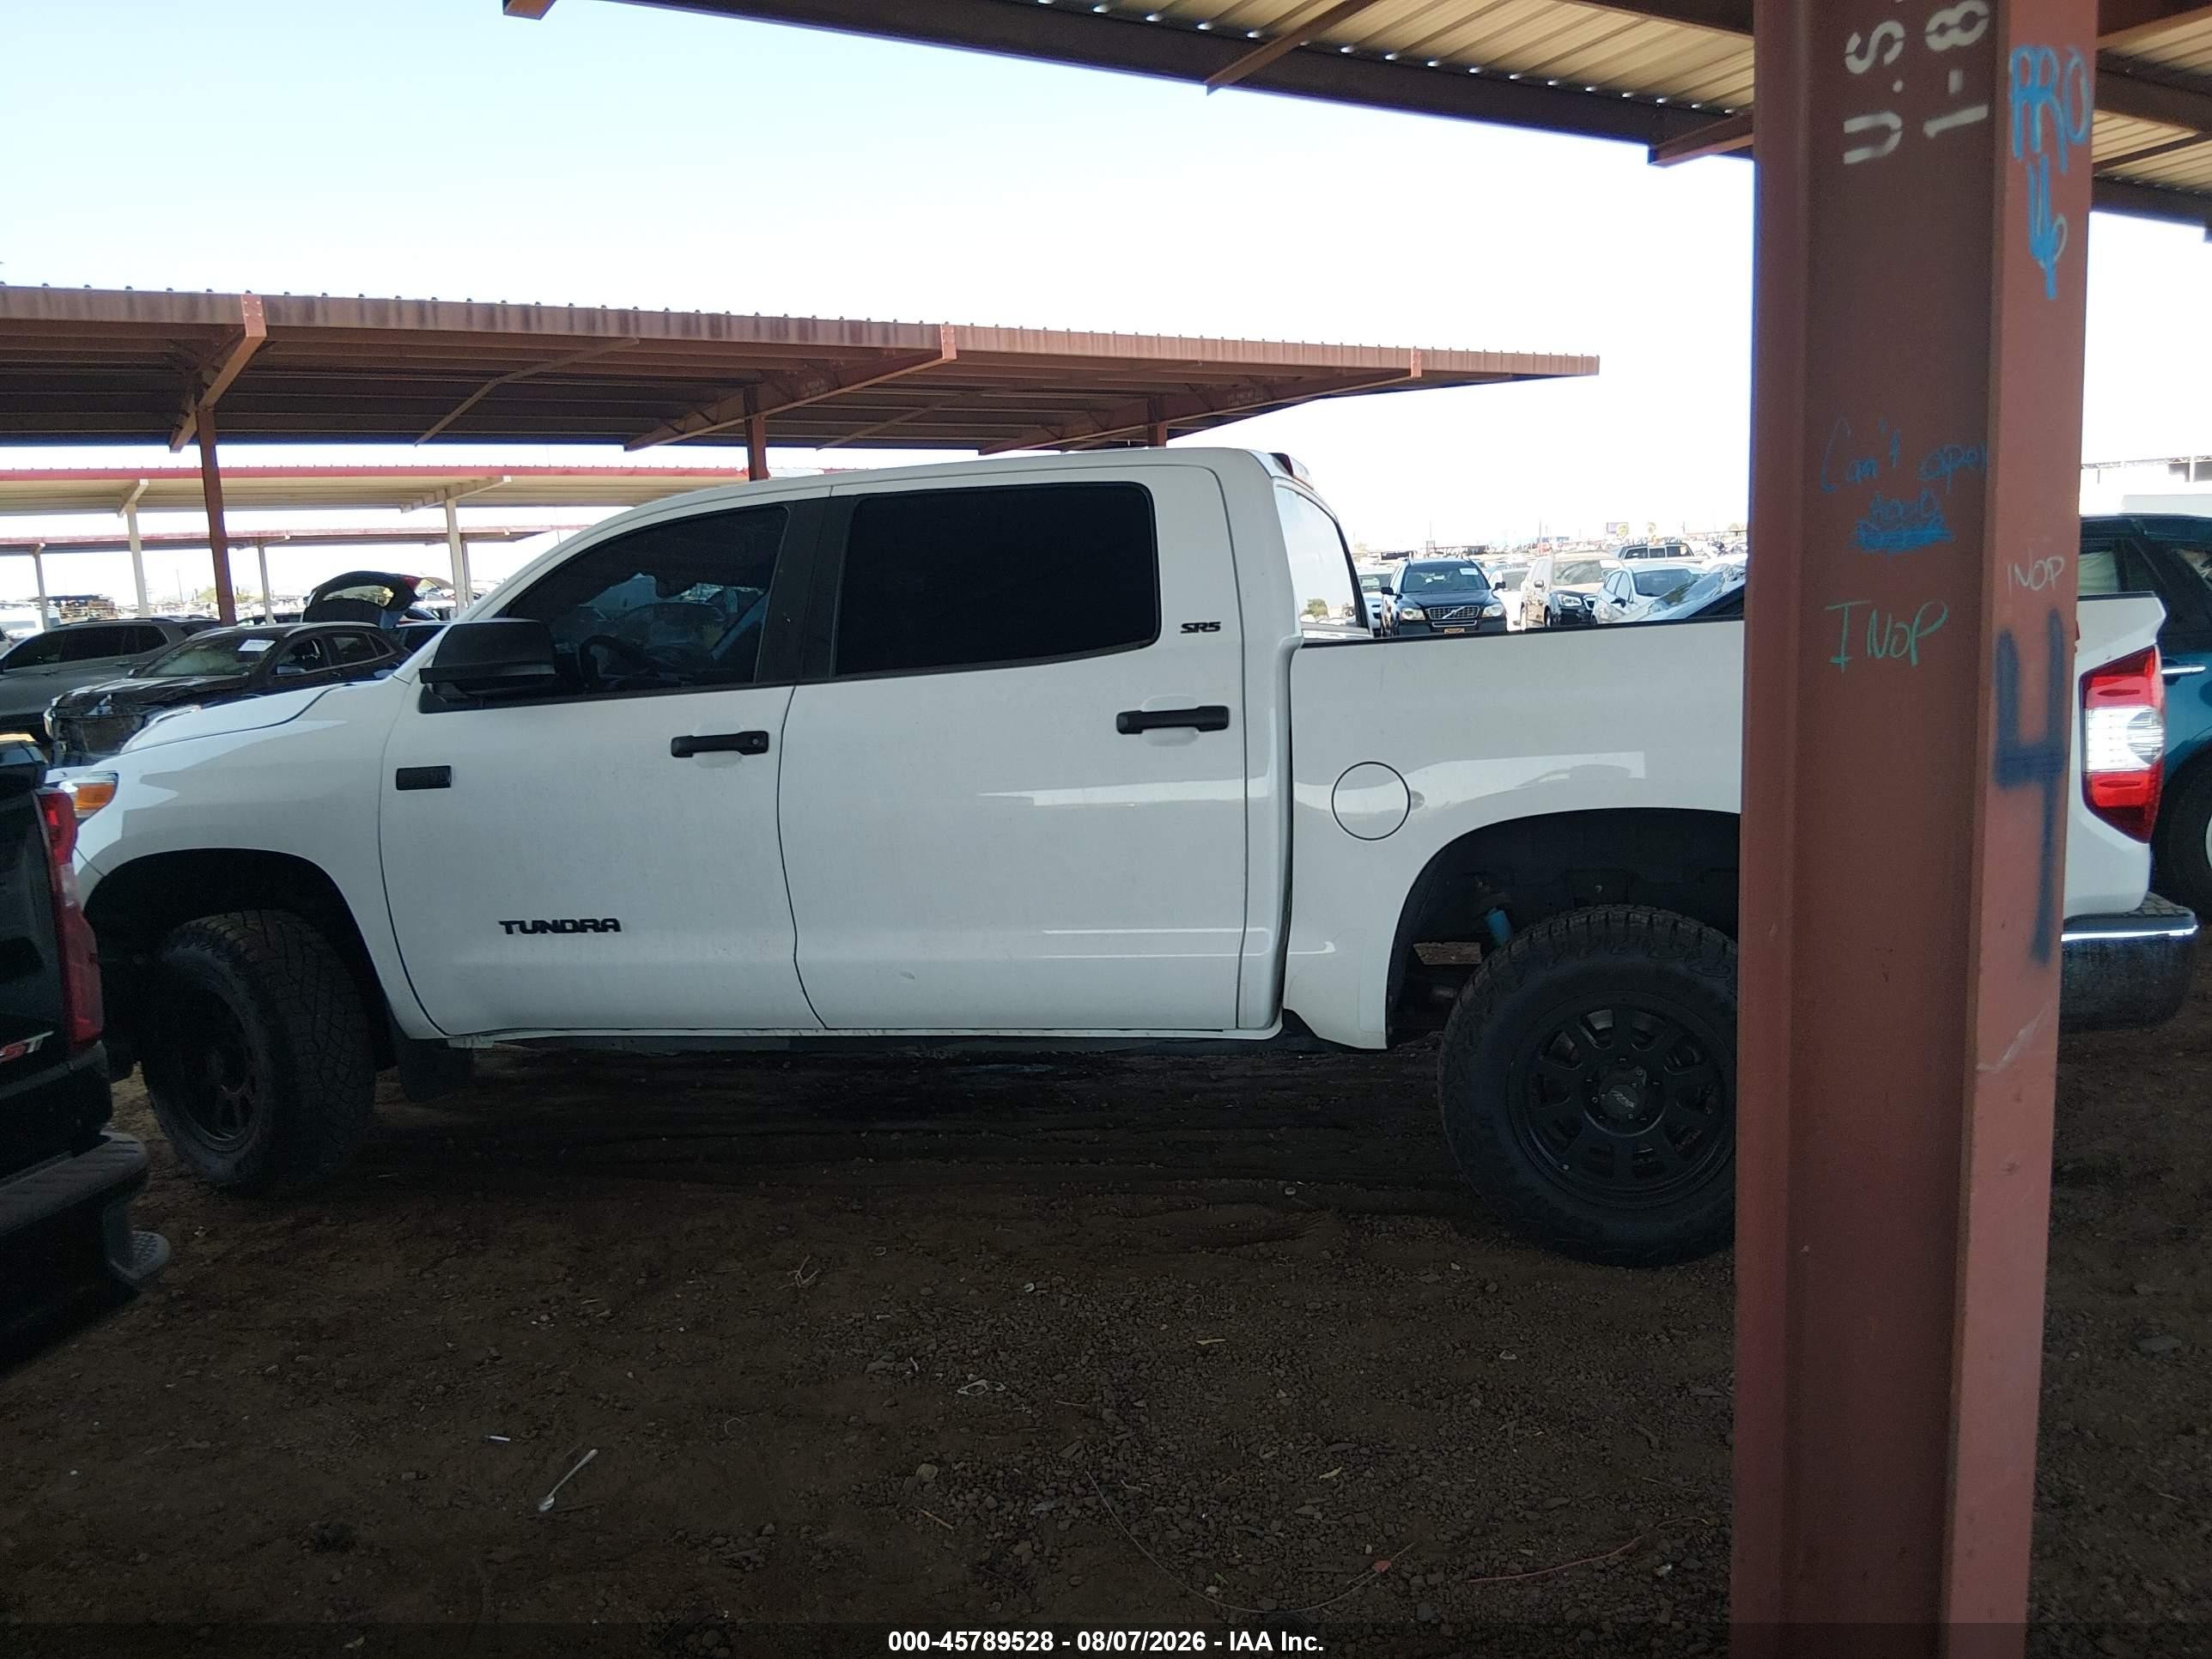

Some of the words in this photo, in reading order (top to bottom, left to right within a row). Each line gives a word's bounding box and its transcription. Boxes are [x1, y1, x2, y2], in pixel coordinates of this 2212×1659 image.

[2007, 550, 2065, 596] INOP
[1181, 621, 1222, 634] SR5
[498, 918, 622, 934] TUNDRA
